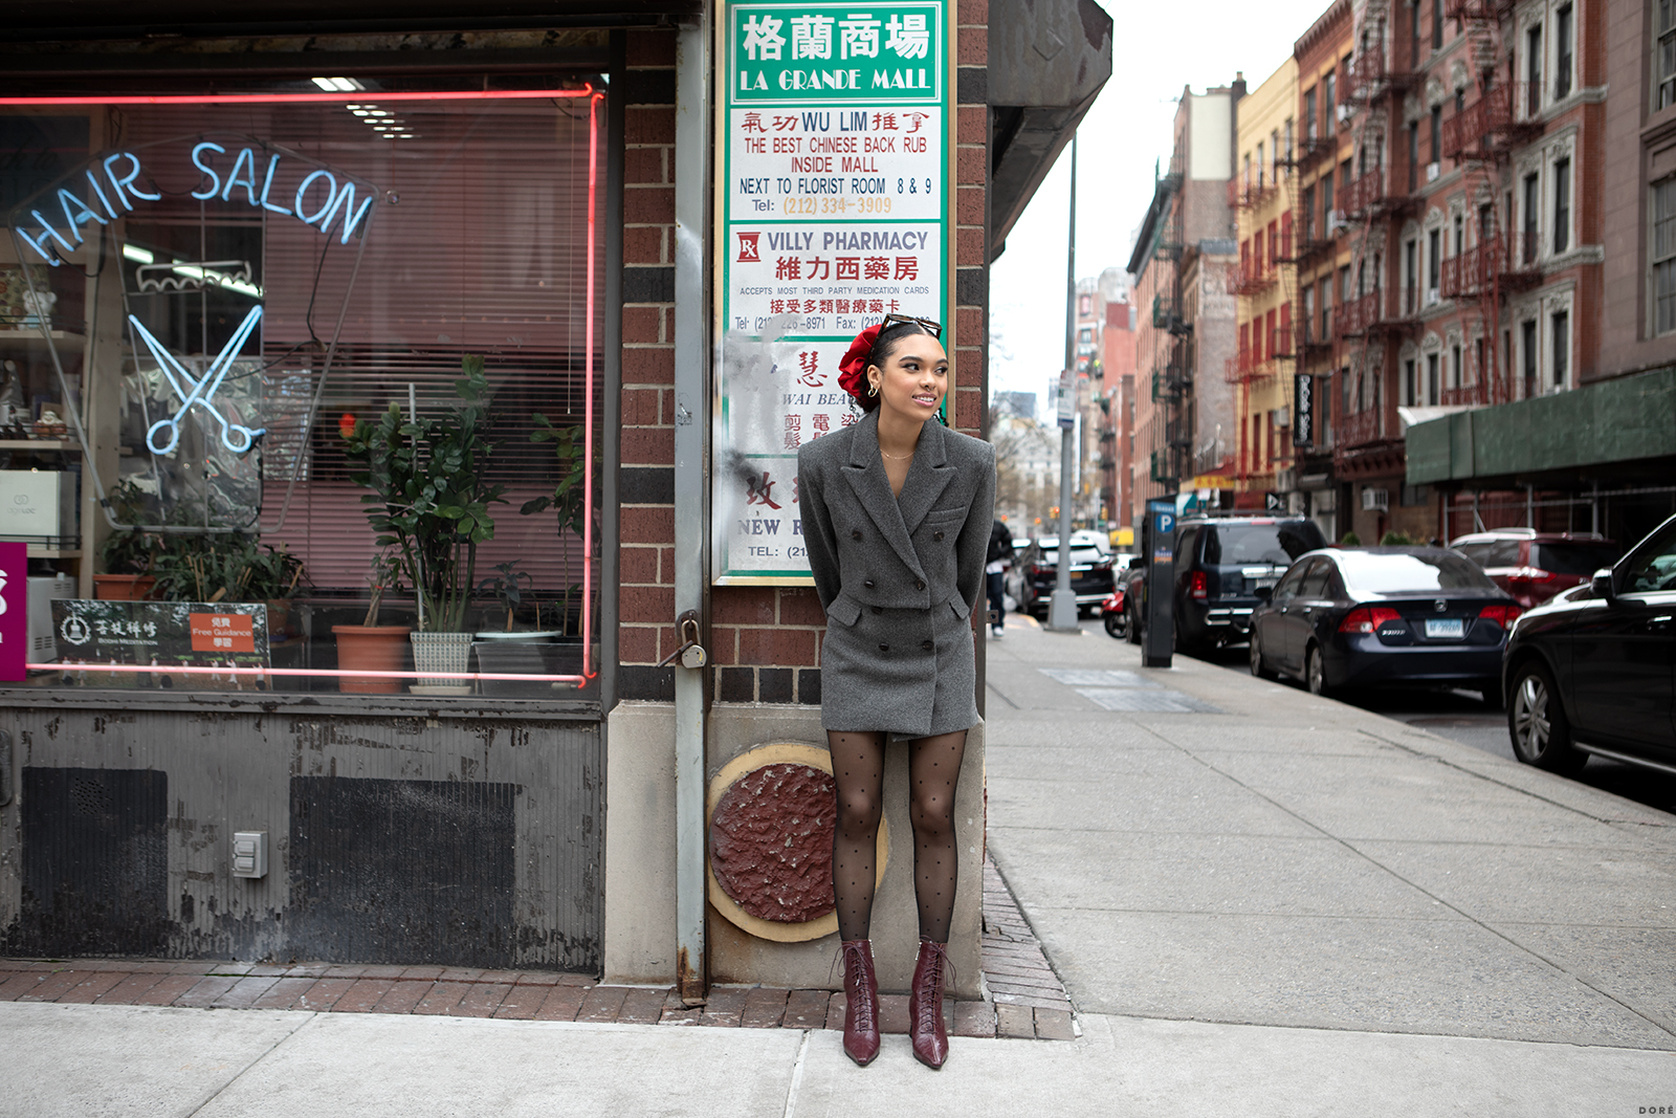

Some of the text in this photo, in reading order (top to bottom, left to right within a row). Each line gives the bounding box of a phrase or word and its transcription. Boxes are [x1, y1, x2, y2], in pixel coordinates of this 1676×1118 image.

[742, 14, 930, 60] 格蘭商場
[740, 68, 931, 90] LA GRANDE MALL
[741, 111, 930, 134] 氣功 WU LIM 推拿
[744, 136, 927, 154] THE BEST CHINESE BACK RUB
[791, 156, 878, 173] INSIDE MALL
[740, 178, 932, 194] NEXT TO FLORIST ROOM 8 & 9
[15, 142, 373, 266] HAIR SALON
[752, 197, 892, 215] Tel: (212) 334-3909
[768, 232, 814, 250] VILLY
[823, 231, 928, 250] PHARMACY
[775, 256, 919, 281] 維力西藥房
[740, 287, 930, 295] ACCEPTS MOST THIRD PARTY MEDICATION CARDS
[770, 298, 900, 314] 接受多類醫療藥卡
[836, 316, 856, 329] Fax:
[783, 394, 812, 405] WAI
[738, 519, 781, 535] NEW
[1161, 514, 1172, 532] P
[748, 546, 809, 559] TEL: (21
[192, 628, 252, 637] Free Guidance
